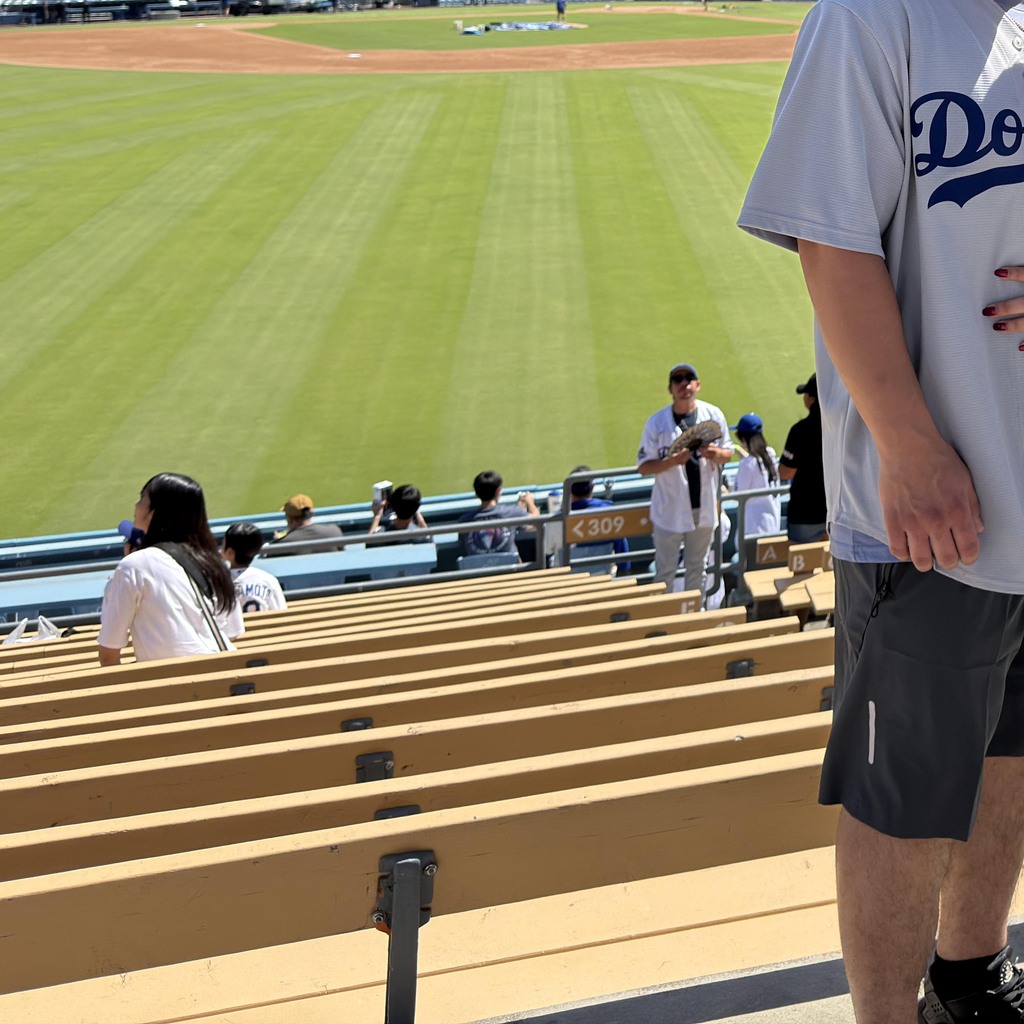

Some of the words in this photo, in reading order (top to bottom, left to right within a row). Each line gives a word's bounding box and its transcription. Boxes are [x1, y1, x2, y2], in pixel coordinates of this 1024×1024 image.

[588, 515, 625, 537] 309
[762, 545, 778, 562] A
[792, 554, 805, 571] B
